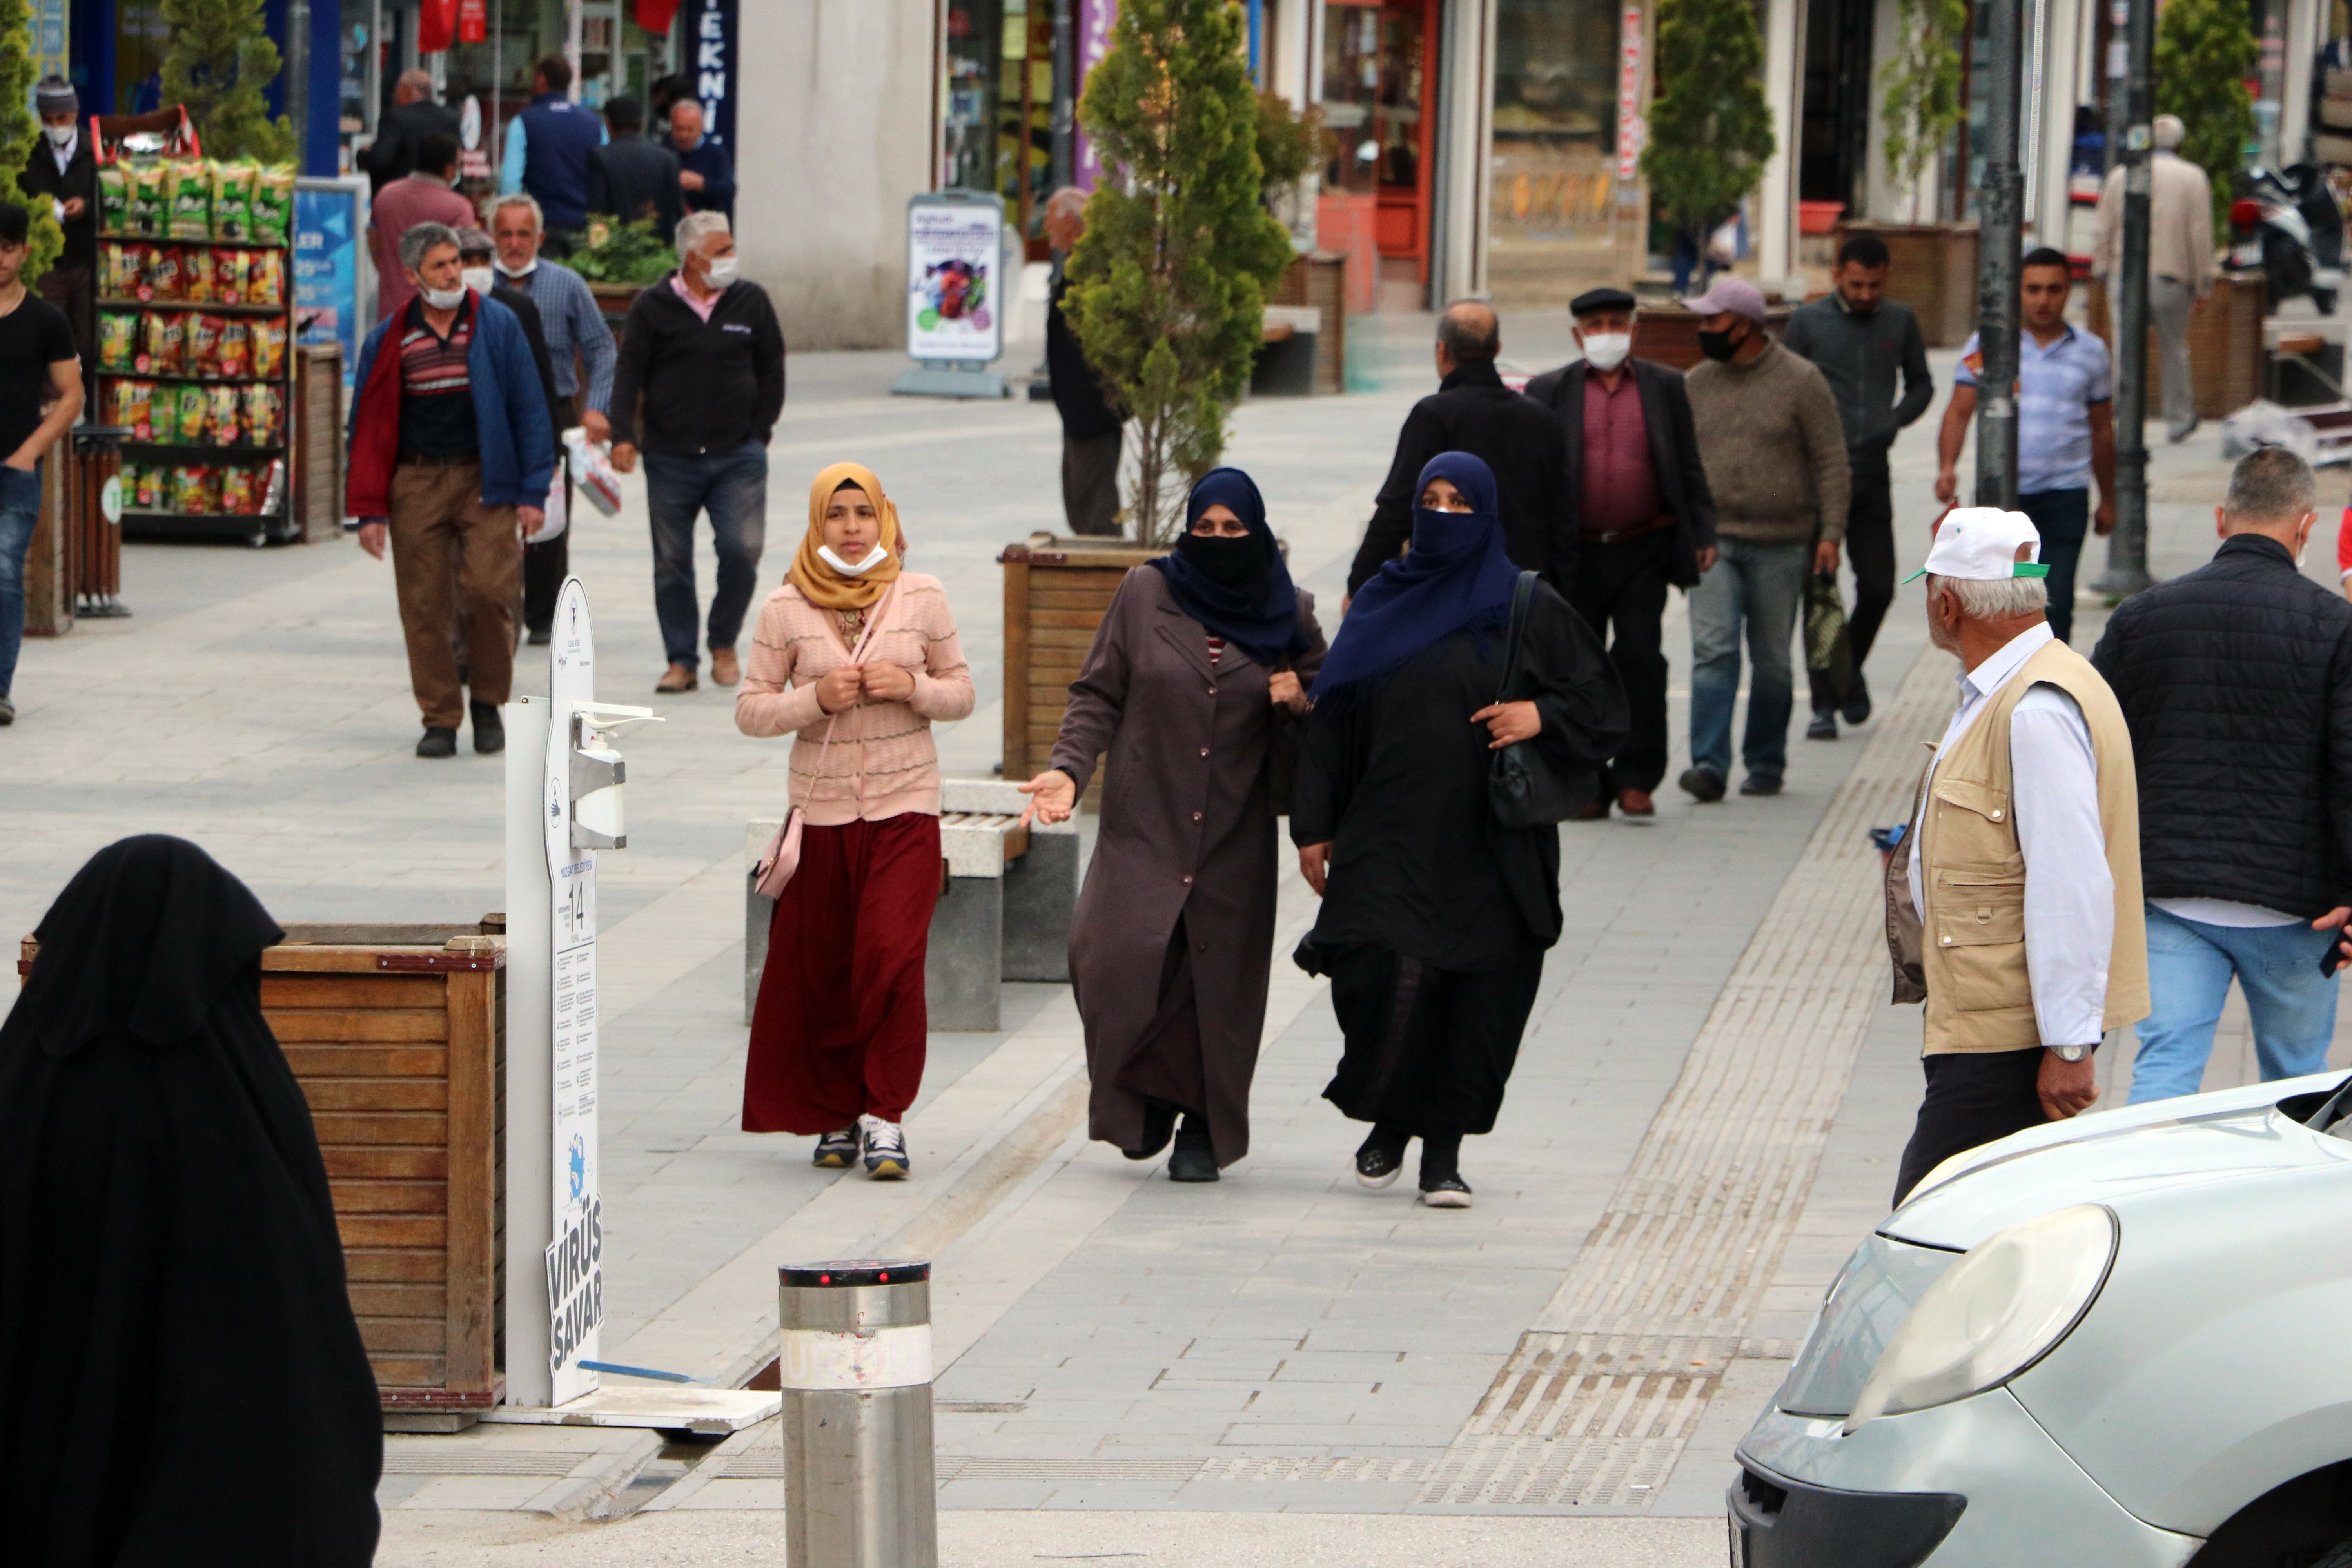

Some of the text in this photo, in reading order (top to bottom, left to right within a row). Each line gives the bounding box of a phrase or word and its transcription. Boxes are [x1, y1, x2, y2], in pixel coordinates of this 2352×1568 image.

[697, 0, 726, 145] EKNİ
[561, 858, 592, 878] YOZGAT BELEDİYESİ
[569, 881, 584, 933] 14
[549, 1194, 601, 1310] VİRÜS
[554, 1269, 601, 1371] SAVAR
